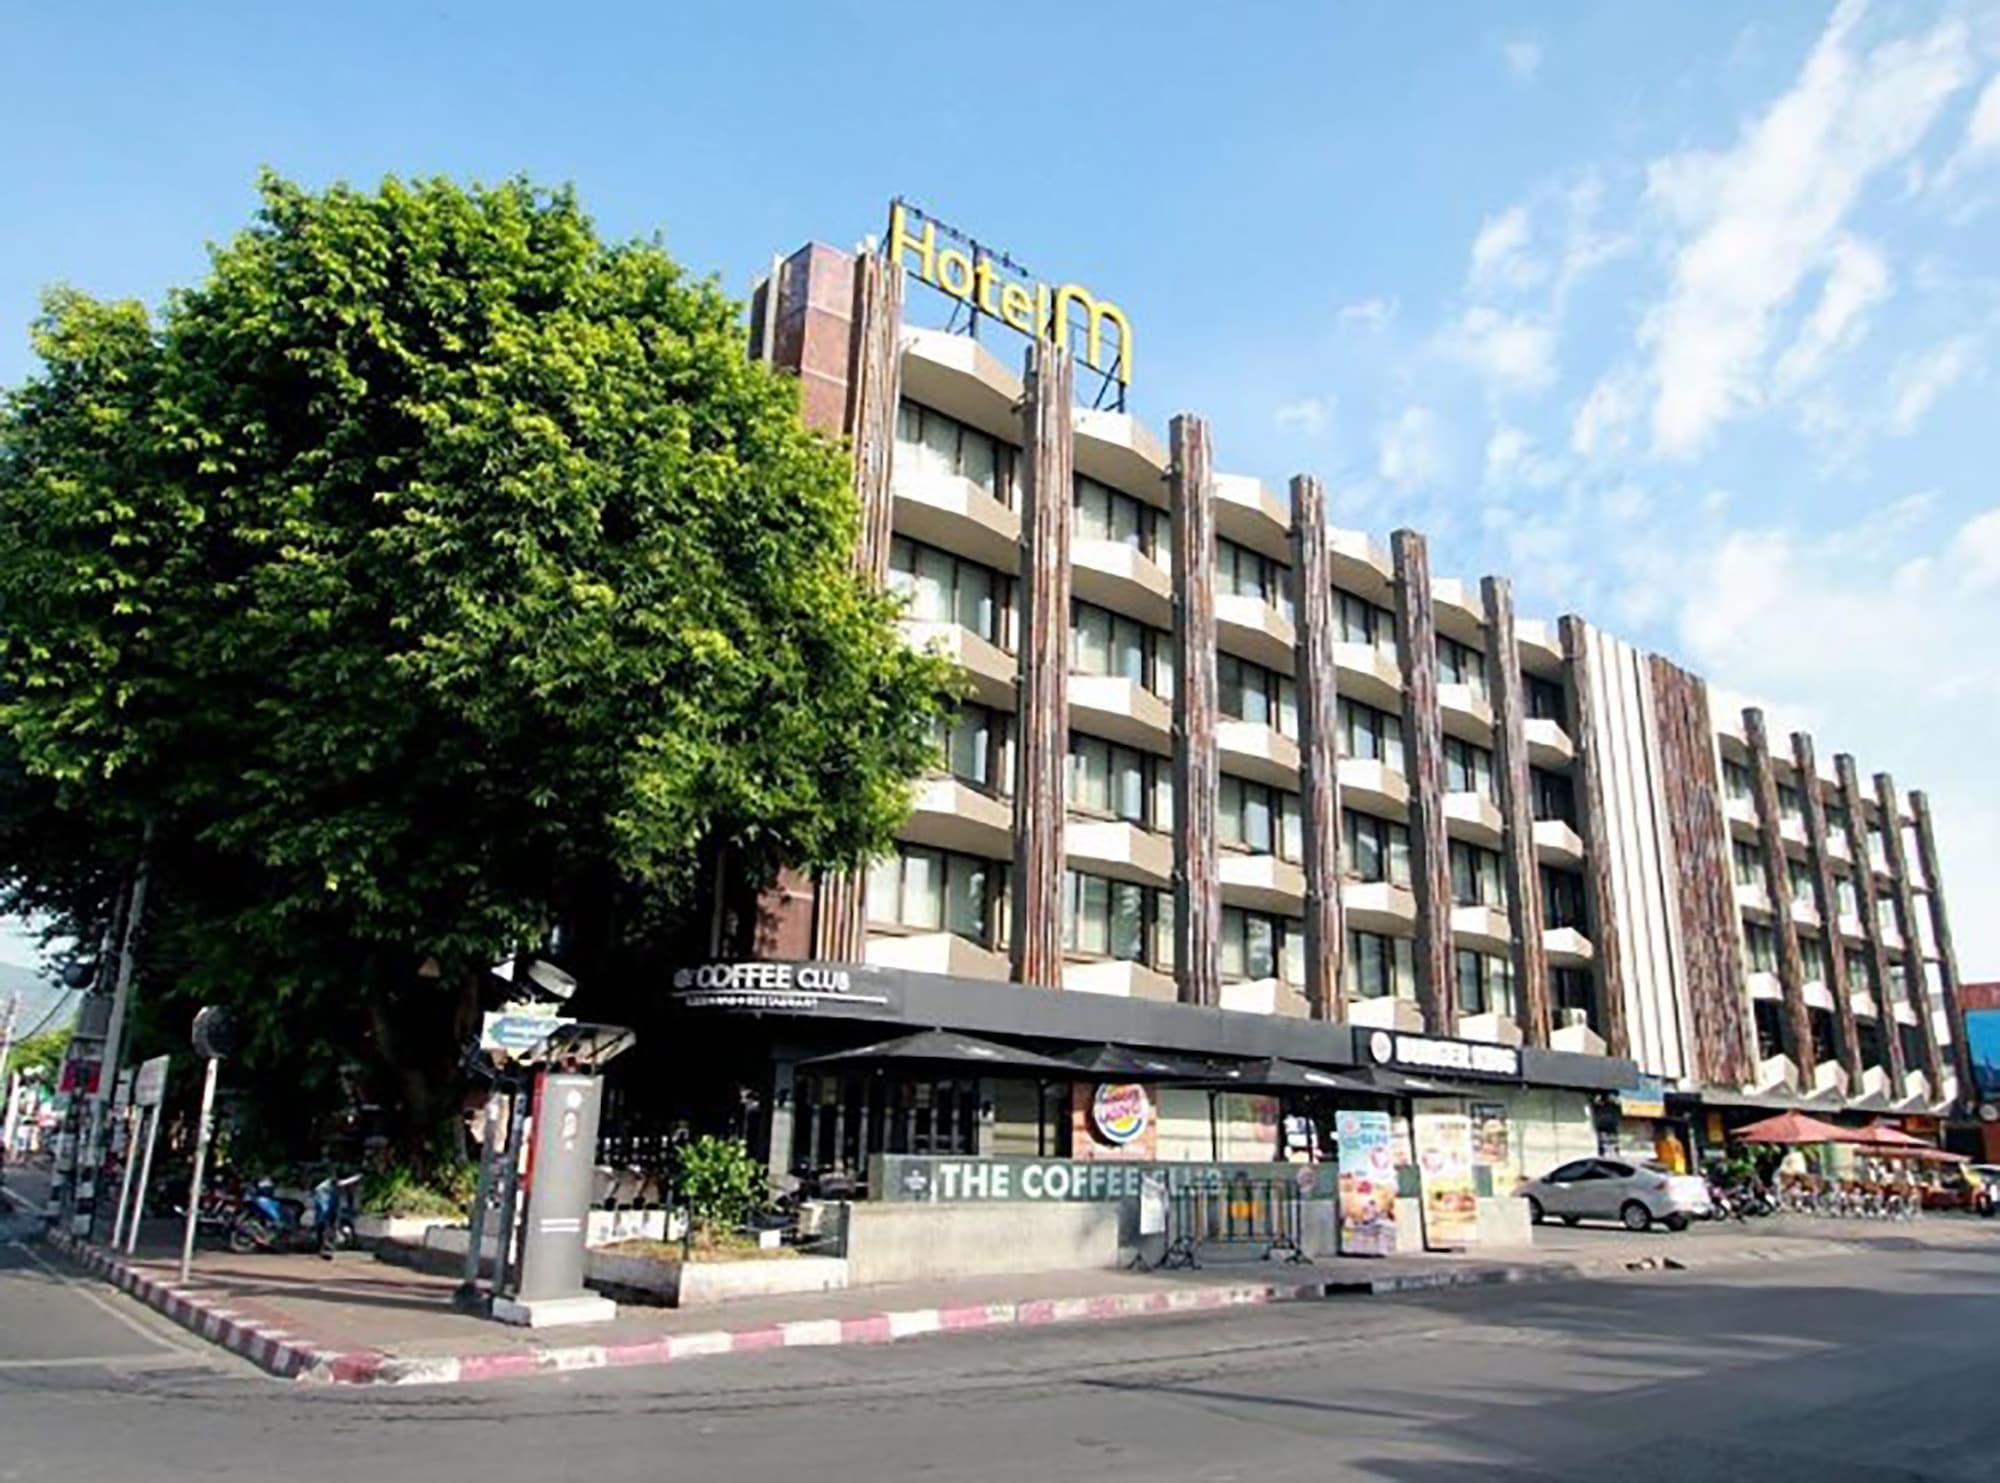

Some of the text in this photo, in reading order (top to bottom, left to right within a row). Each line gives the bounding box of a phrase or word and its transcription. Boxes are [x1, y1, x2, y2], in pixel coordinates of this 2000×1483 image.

[891, 205, 1049, 338] Hotel
[697, 963, 850, 991] COFFEE CLUB
[940, 1163, 1010, 1197] THE
[1022, 1163, 1139, 1197] COFFEE
